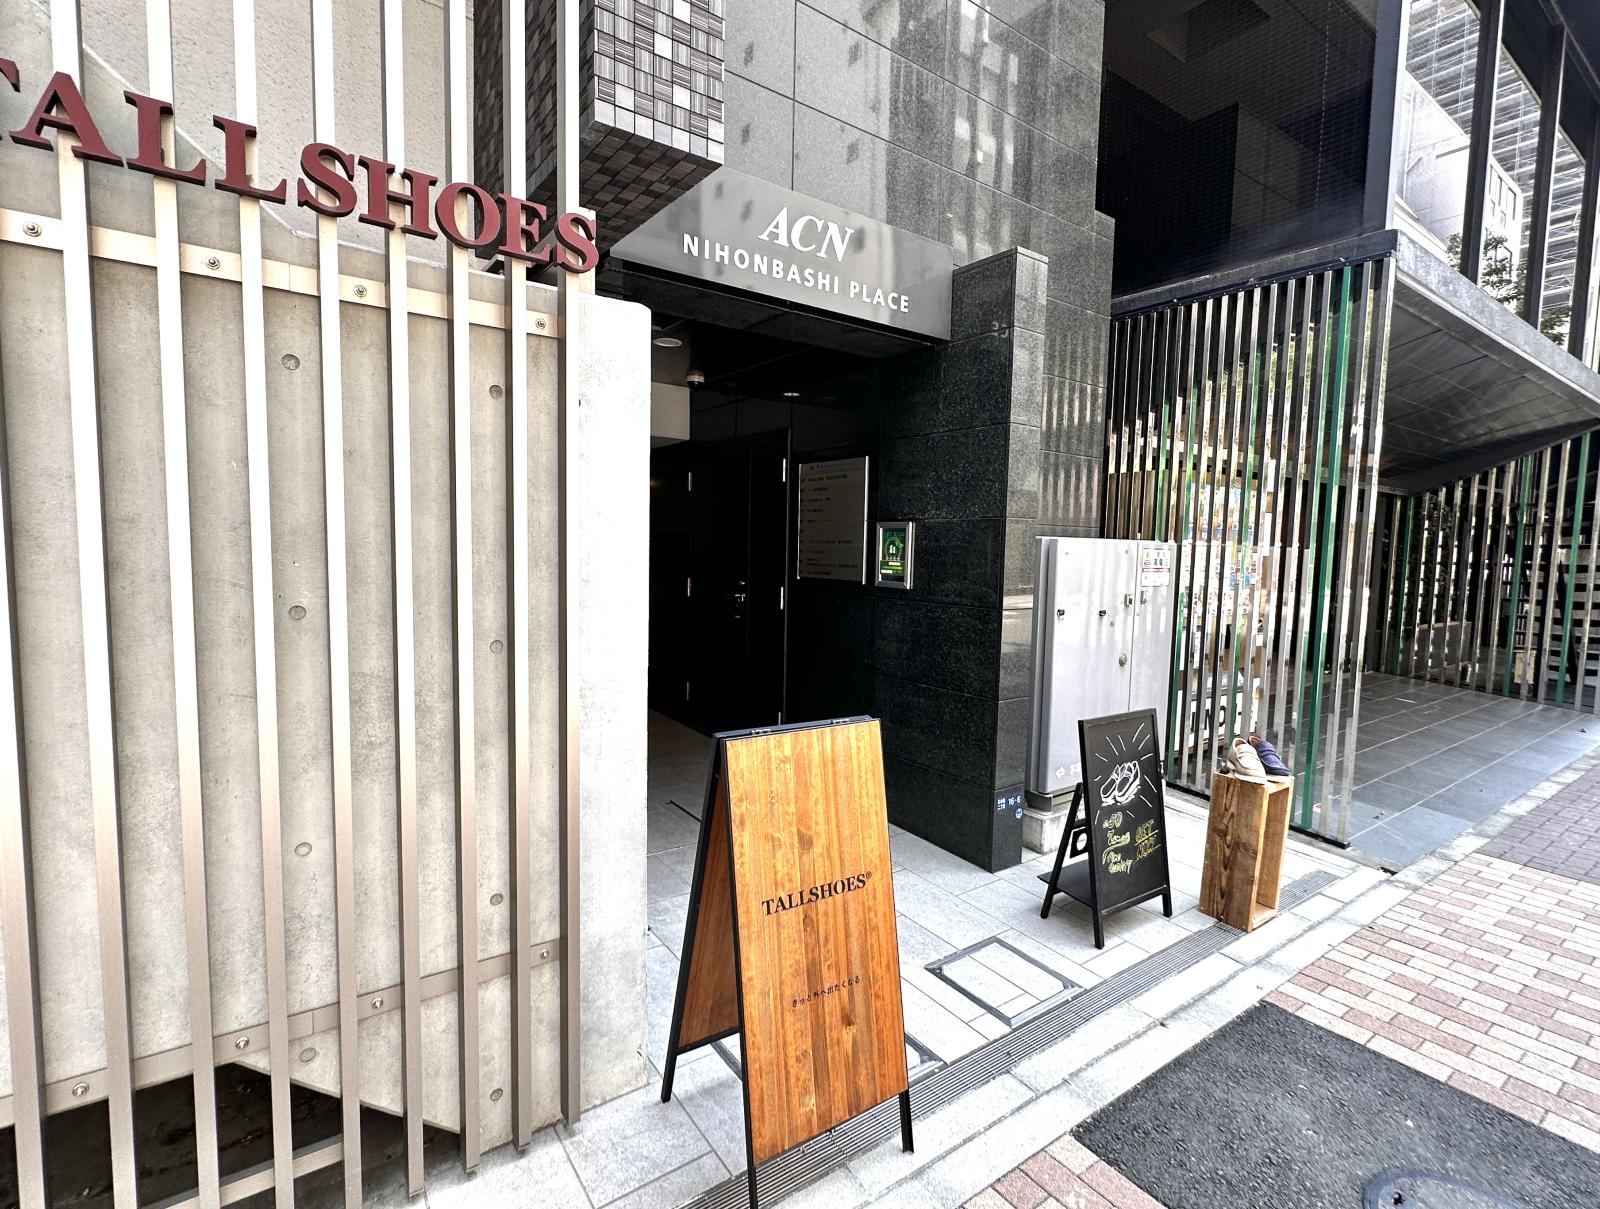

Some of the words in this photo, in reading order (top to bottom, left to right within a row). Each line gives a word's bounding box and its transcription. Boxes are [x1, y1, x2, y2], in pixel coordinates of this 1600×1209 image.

[0, 57, 599, 274] ALLSHOES
[757, 206, 857, 263] ACN
[682, 232, 840, 296] NIHONBASHI
[849, 280, 910, 314] PLACE
[791, 975, 861, 1008] きっと外へ出たくなる
